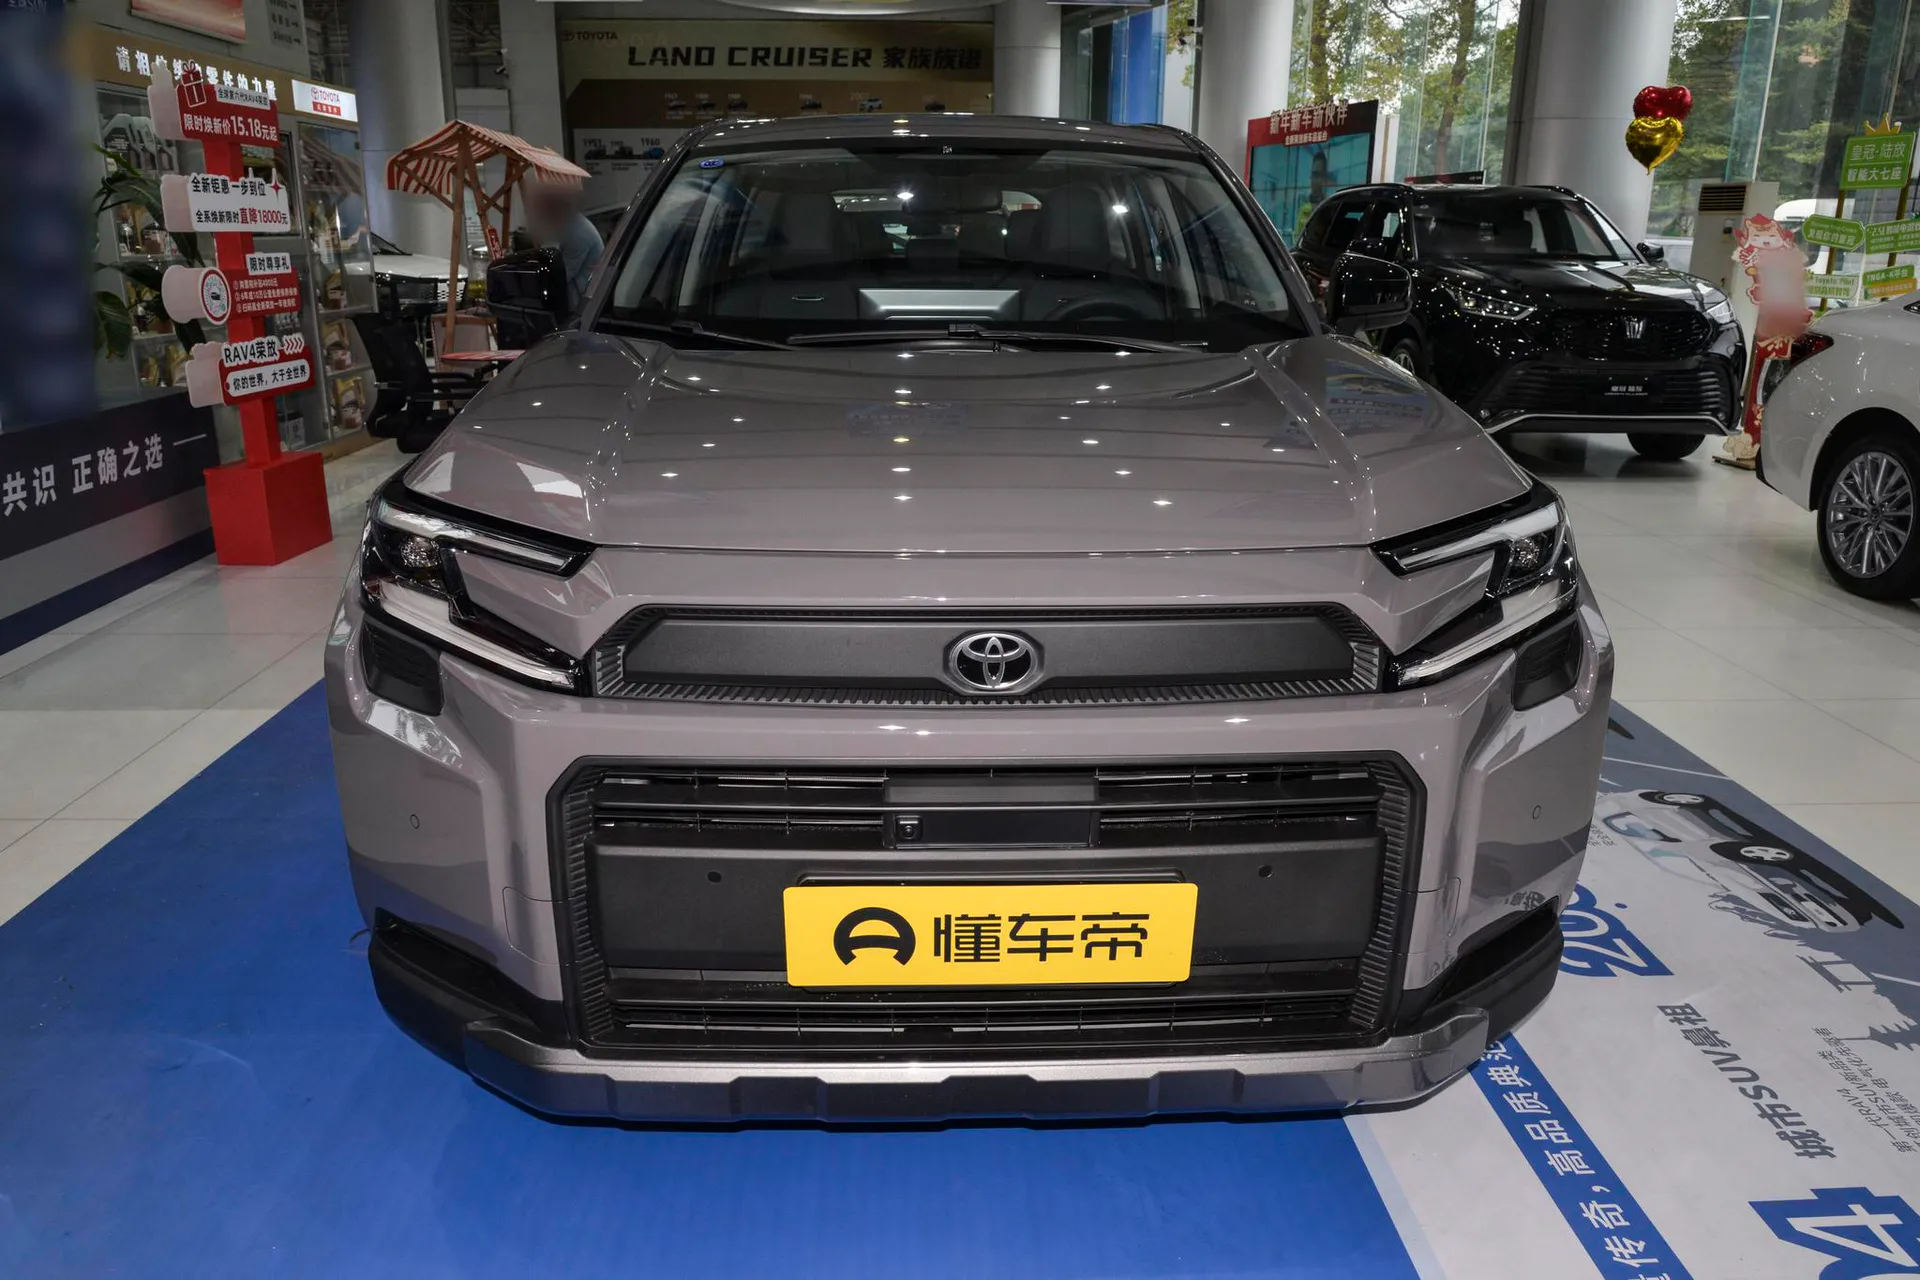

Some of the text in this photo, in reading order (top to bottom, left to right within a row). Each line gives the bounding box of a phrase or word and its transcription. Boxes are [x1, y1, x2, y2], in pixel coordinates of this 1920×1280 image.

[576, 31, 618, 41] TOYOTA
[628, 46, 716, 67] LAND
[727, 46, 872, 68] CRUISER
[183, 113, 279, 142] 限时焕新价15.18元起
[1270, 100, 1348, 135] 新年新车新伙伴
[1850, 142, 1906, 161] 皇冠·陆放
[1847, 166, 1902, 182] 智能大七座
[195, 207, 288, 225] 全系焕新限时直降18000元
[224, 339, 279, 364] RAV4荣放
[2, 432, 164, 517] 共识 正确之选
[933, 911, 1150, 963] 懂车帝
[1657, 1002, 1837, 1159] 城市SUV鼻祖
[1836, 1088, 1918, 1153] 第一代RAV4
